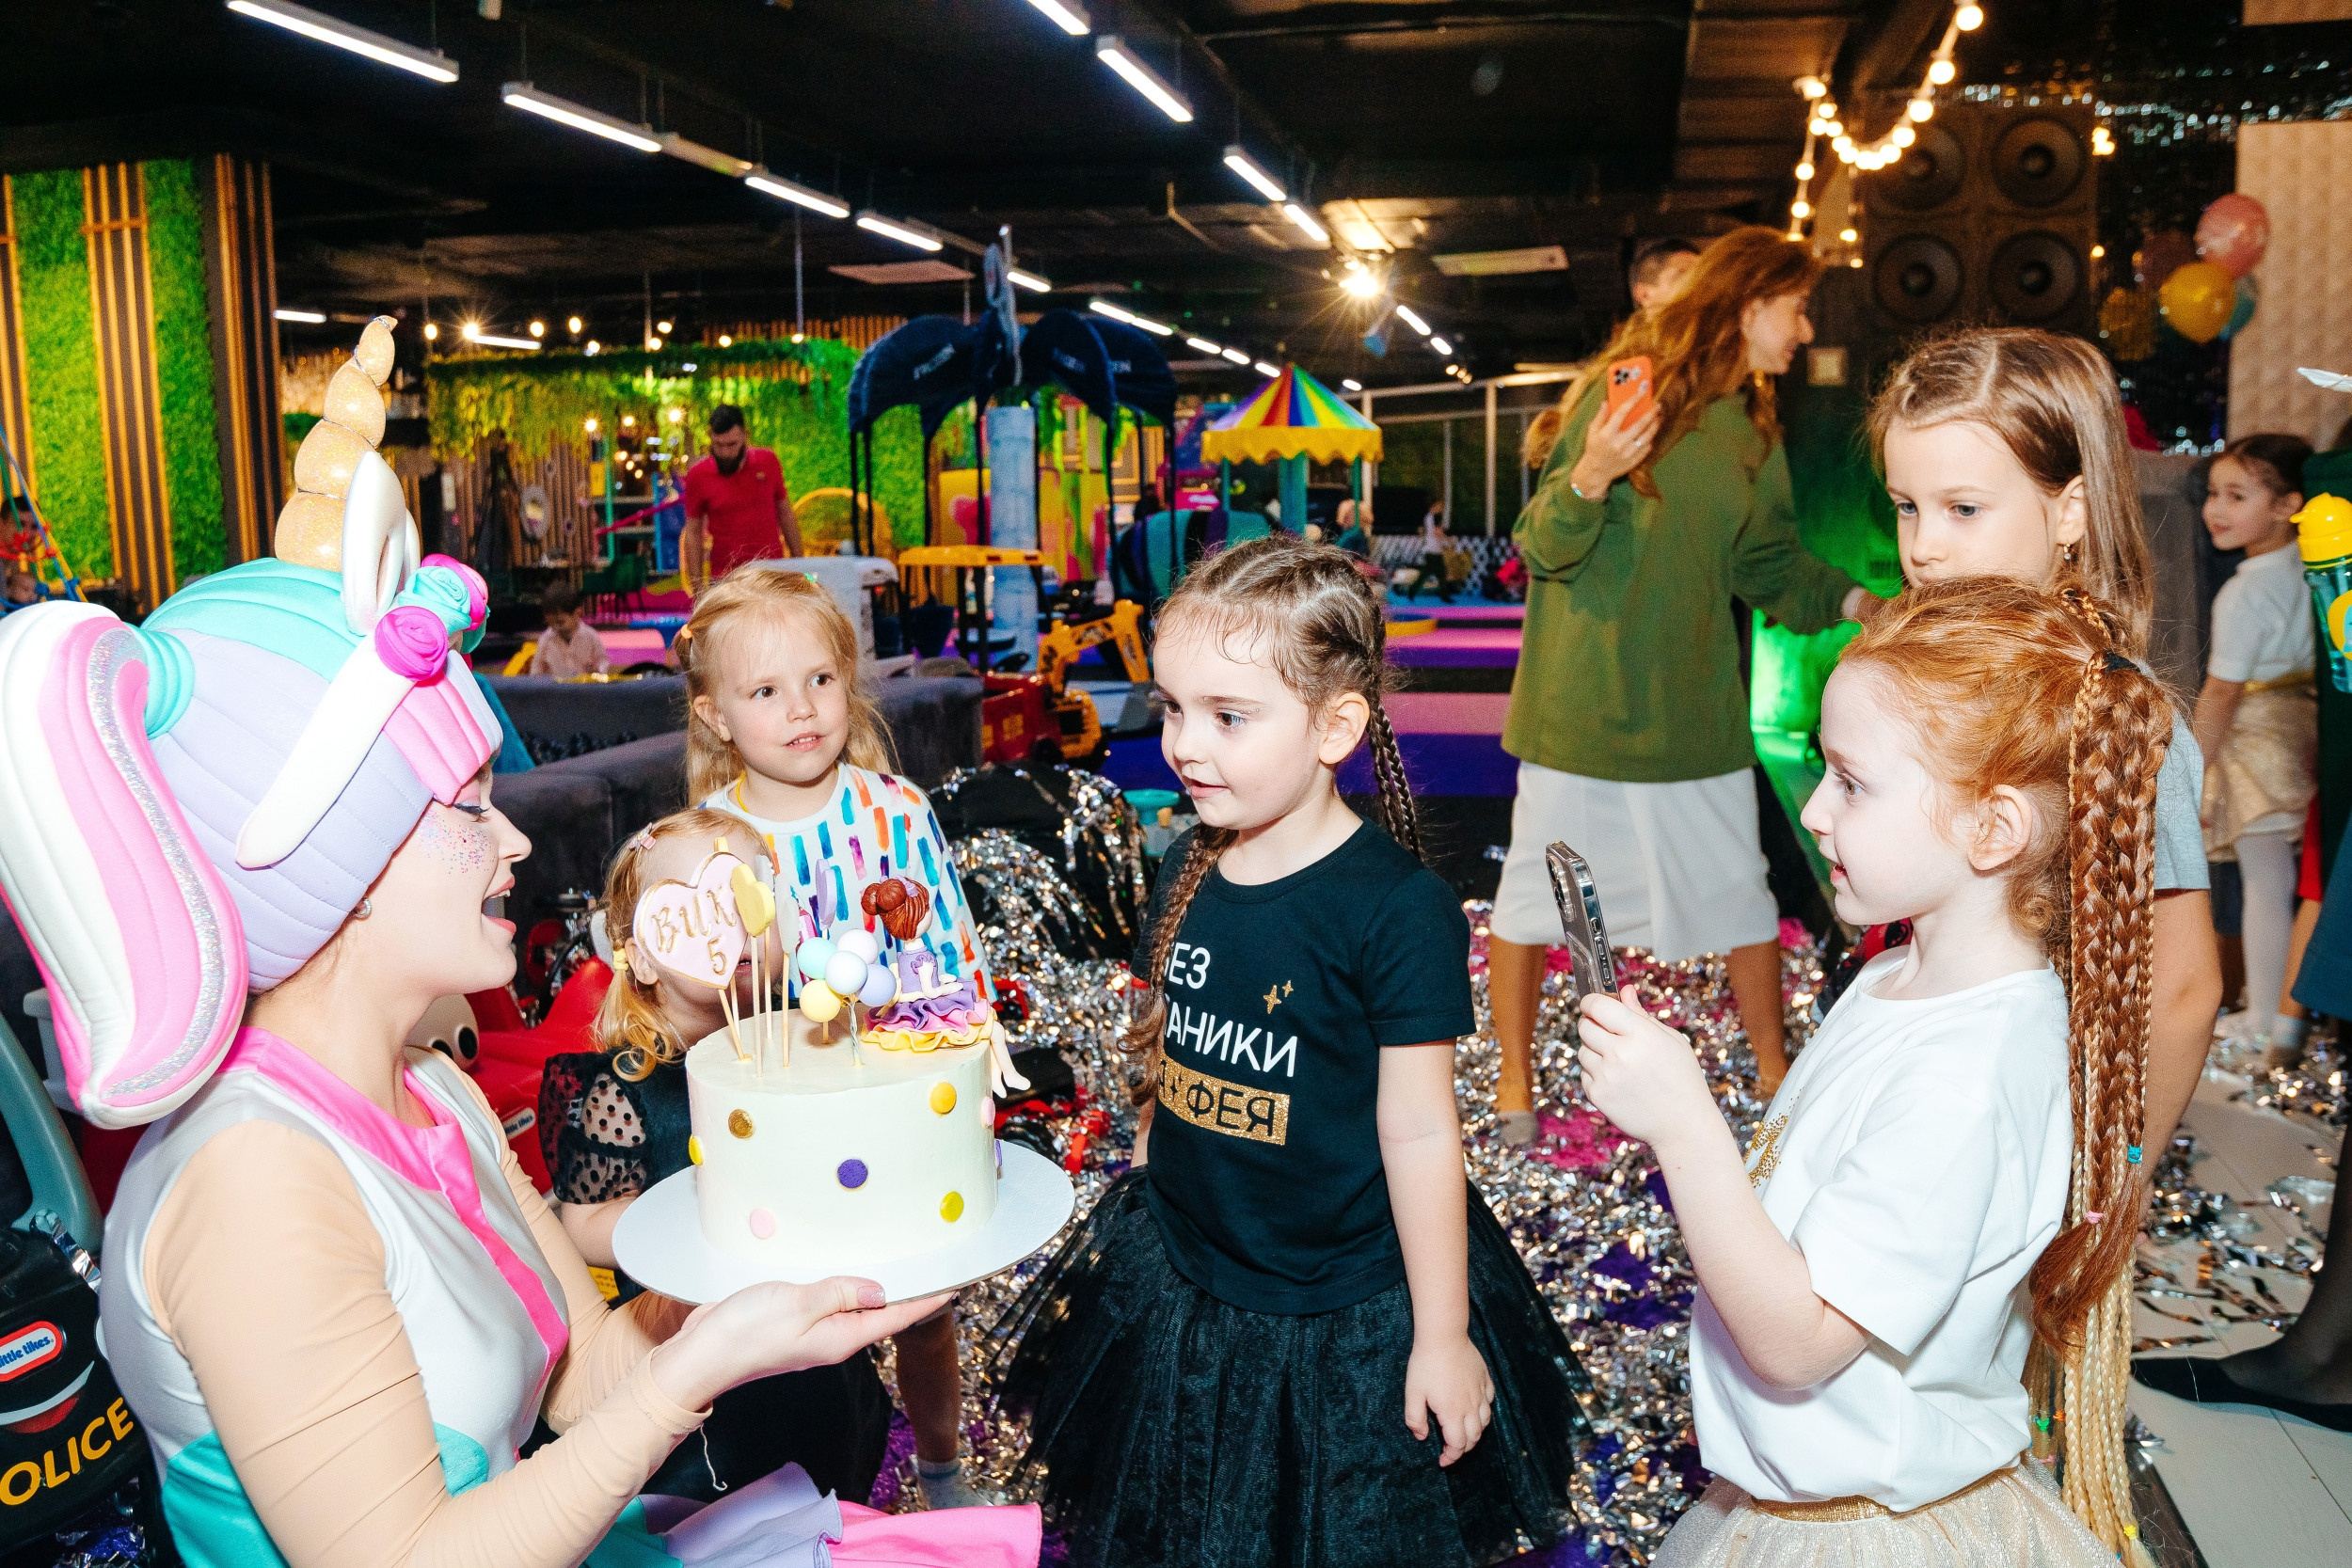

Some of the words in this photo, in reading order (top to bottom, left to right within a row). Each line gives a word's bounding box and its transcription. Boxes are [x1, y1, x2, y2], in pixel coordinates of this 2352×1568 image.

[707, 934, 728, 975] 5
[1164, 942, 1211, 990] ЕЗ
[1164, 993, 1298, 1078] АНИКИ
[1186, 1081, 1277, 1137] ФЕЯ
[22, 1336, 51, 1354] tikes
